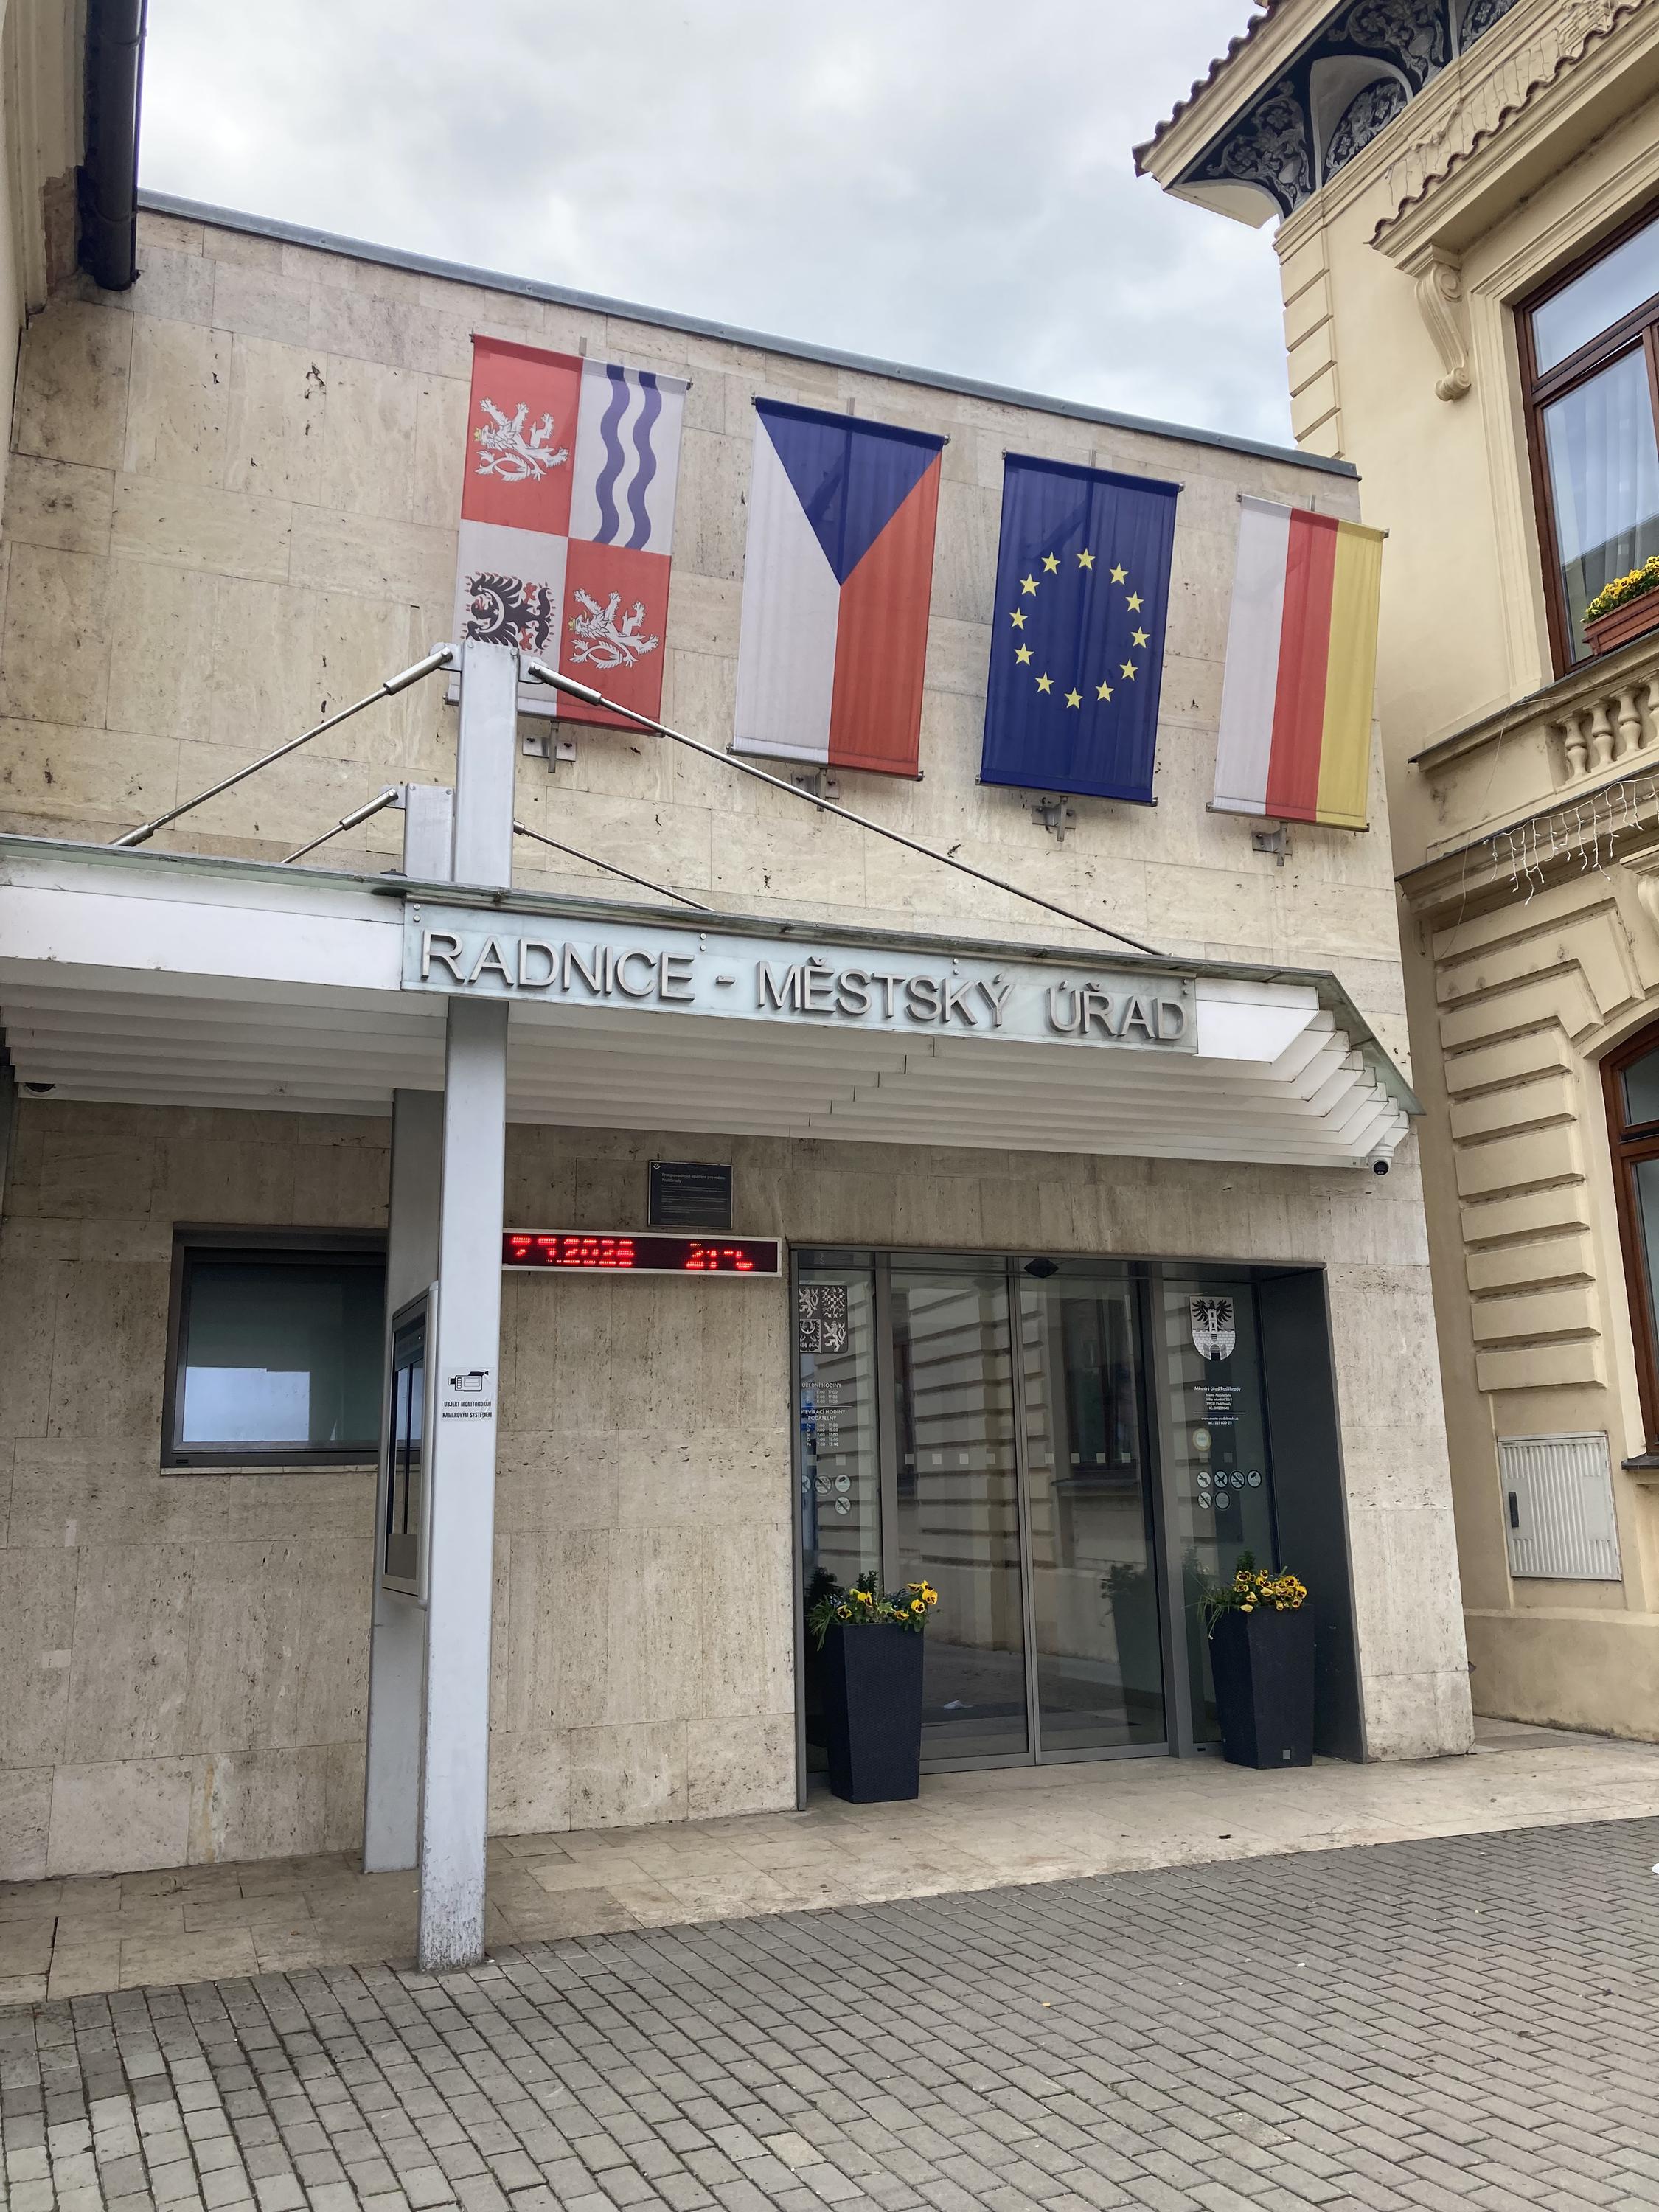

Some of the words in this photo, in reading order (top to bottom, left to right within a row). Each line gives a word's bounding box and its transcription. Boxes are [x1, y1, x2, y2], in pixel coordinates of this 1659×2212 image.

[422, 928, 695, 1002] RADNICE
[715, 974, 736, 986] -
[757, 955, 1017, 1028] MĚSTSKÝ
[1047, 978, 1190, 1041] ÚŘAD
